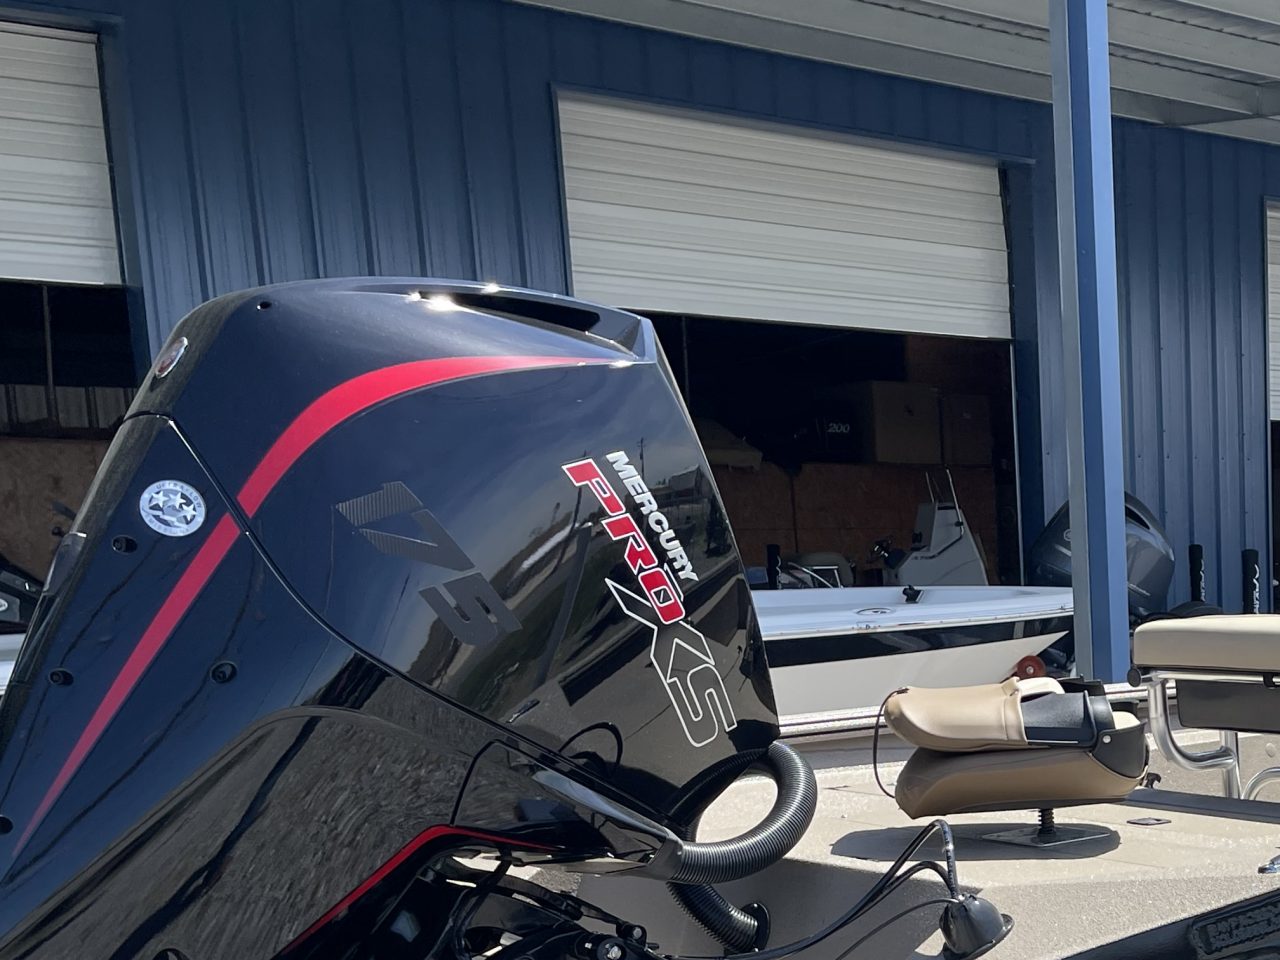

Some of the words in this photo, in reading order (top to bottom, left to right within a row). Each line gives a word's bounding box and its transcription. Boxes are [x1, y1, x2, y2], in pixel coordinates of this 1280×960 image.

[826, 422, 851, 434] 200
[561, 457, 686, 625] PRO
[605, 450, 699, 582] MERCURY
[604, 563, 737, 748] XS
